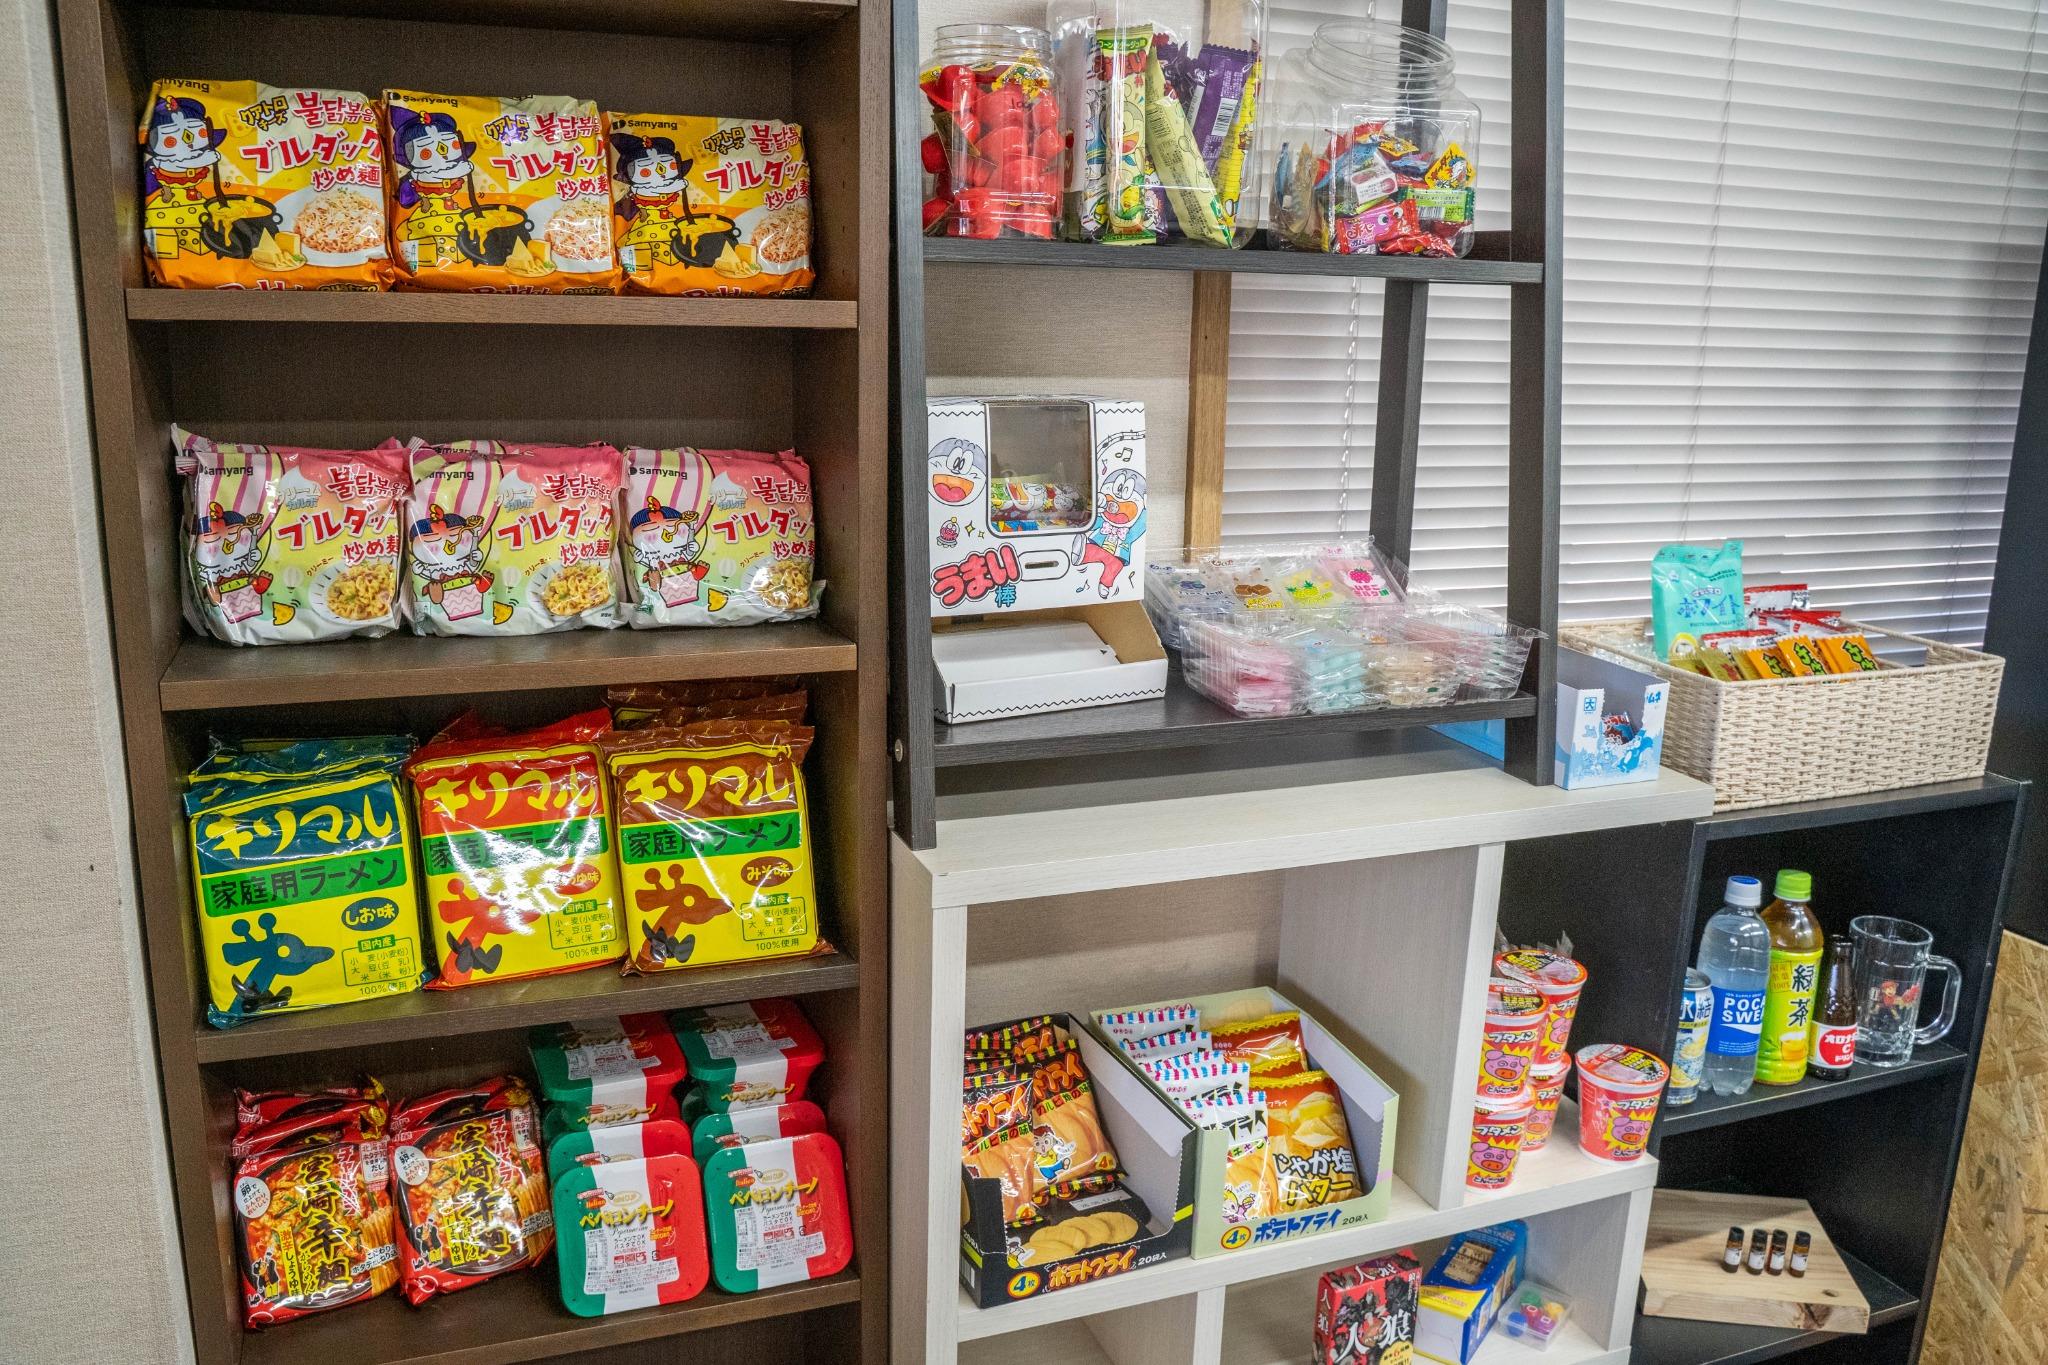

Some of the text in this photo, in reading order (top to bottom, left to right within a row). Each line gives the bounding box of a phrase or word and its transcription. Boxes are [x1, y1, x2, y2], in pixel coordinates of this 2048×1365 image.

[240, 96, 288, 124] クアトロ
[258, 113, 287, 131] チーズ
[242, 129, 381, 170] ブルダック
[704, 127, 746, 151] クアトロ
[312, 167, 380, 189] 炒め麺
[560, 539, 609, 565] 炒め麺
[933, 544, 1020, 607] うまい
[994, 583, 1017, 608] 棒
[210, 858, 398, 911] 家庭用ラーメン
[747, 862, 791, 881] みそ味
[345, 903, 396, 926] しお味
[564, 944, 608, 960] 100%使用
[757, 938, 799, 951] 100%使用
[1789, 964, 1815, 1027] 緑茶
[1722, 1009, 1763, 1023] SWE
[1273, 1147, 1355, 1179] じゃが塩
[1253, 1209, 1342, 1244] ポテトフライ
[1050, 1247, 1168, 1291] ポテトフライ 20袋入
[1334, 1308, 1412, 1363] 人狼
